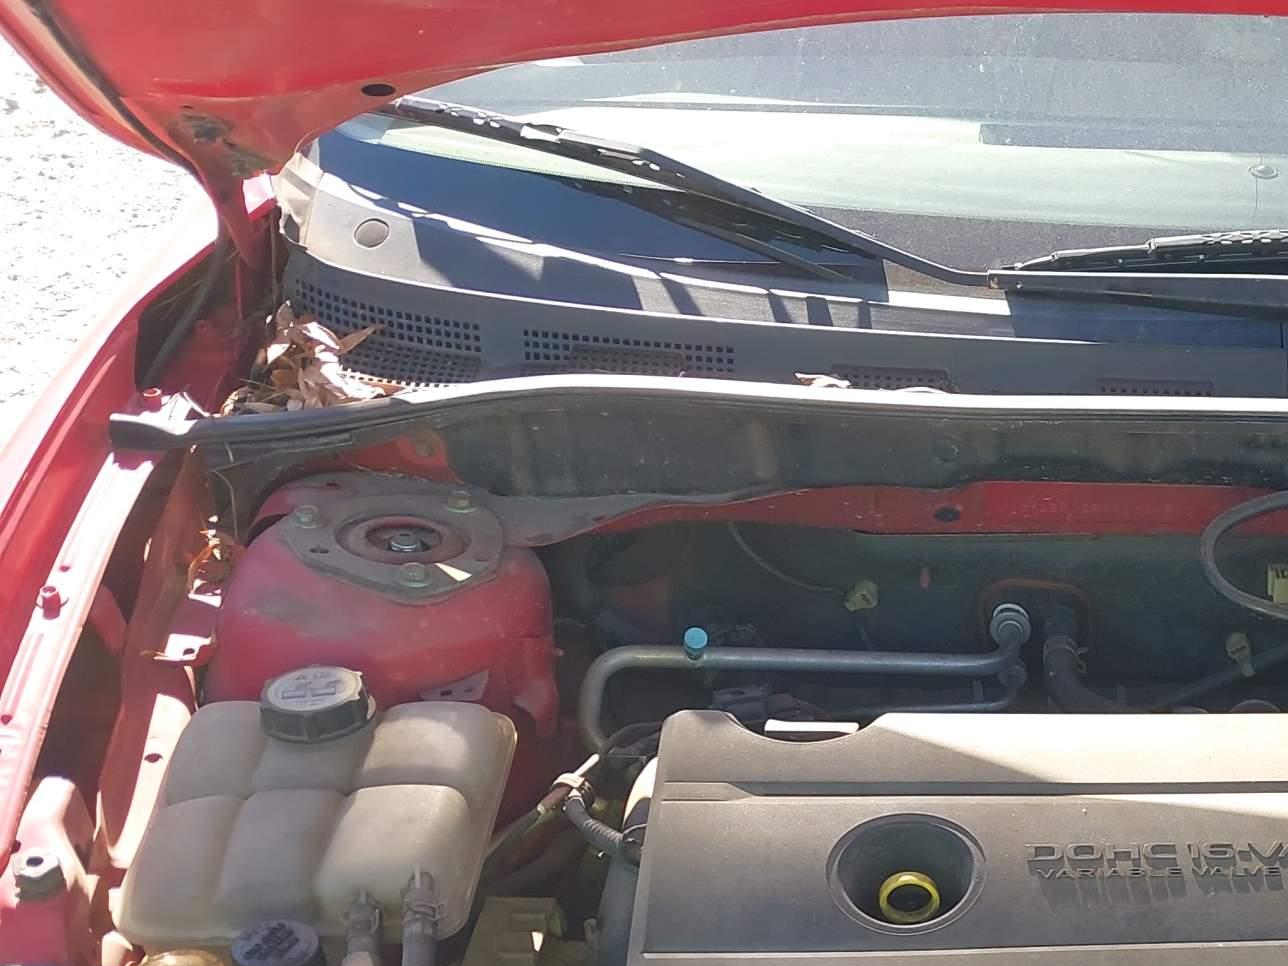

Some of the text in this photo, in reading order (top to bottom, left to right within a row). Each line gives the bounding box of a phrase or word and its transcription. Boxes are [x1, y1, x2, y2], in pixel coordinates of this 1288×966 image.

[1025, 842, 1178, 862] DOHC
[1037, 867, 1184, 880] VARIABLE
[1192, 865, 1281, 878] VALVE
